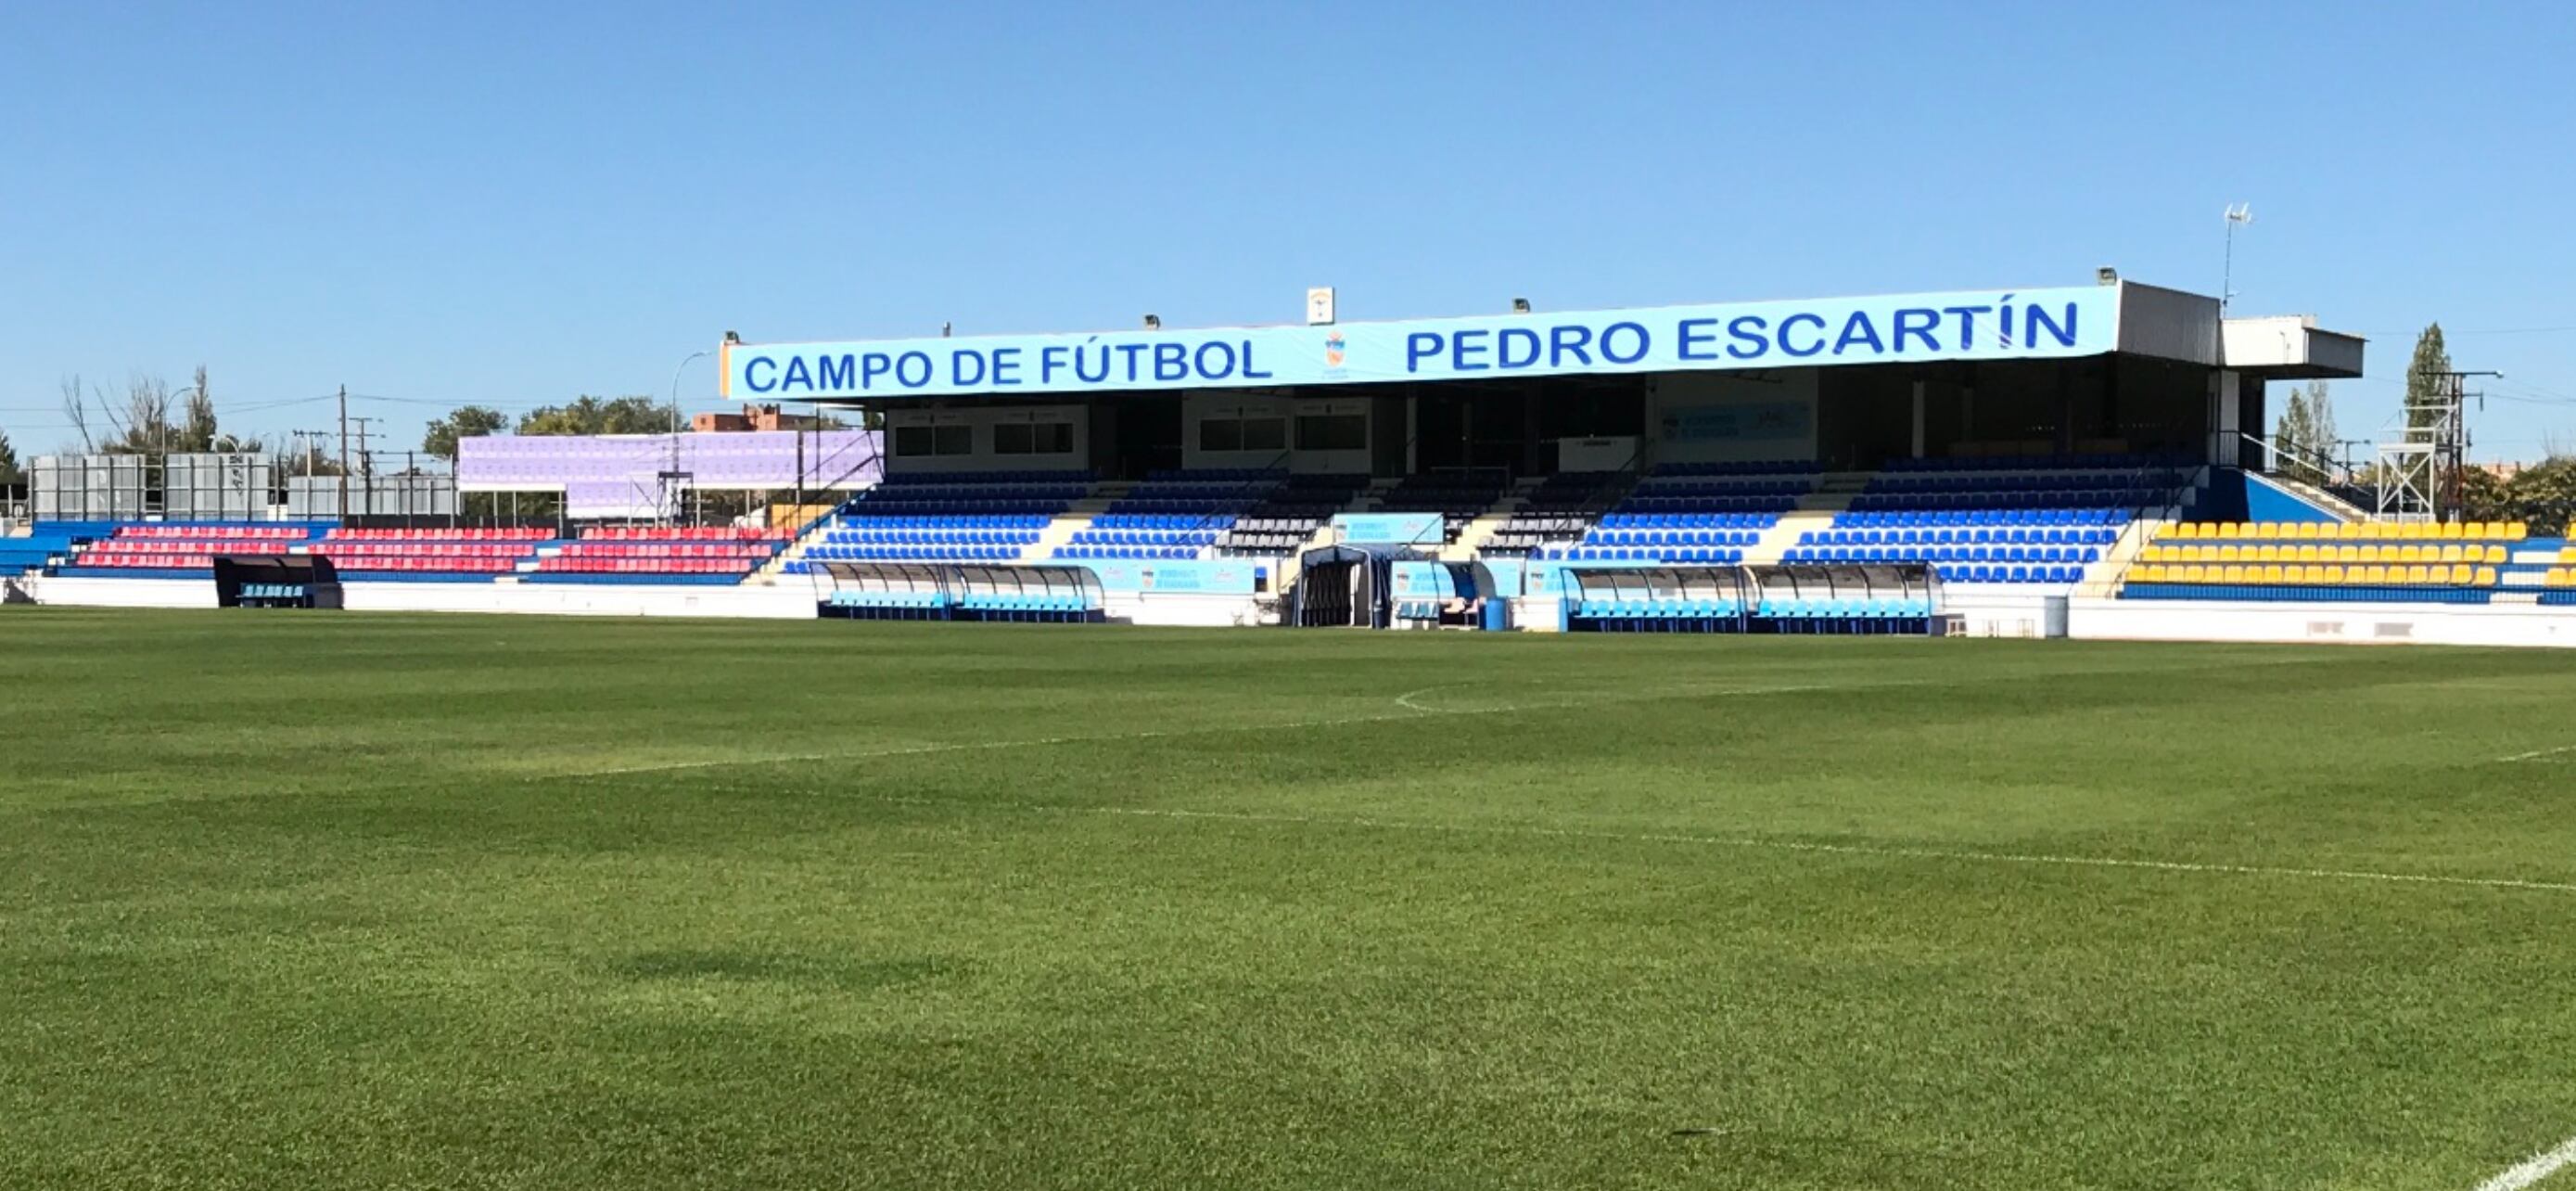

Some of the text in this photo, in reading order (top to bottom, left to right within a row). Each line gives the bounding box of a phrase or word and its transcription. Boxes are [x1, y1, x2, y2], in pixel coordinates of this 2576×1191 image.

[745, 292, 2078, 392] CAMPO DE FÚTBOL PEDRO ESCARTÍN
